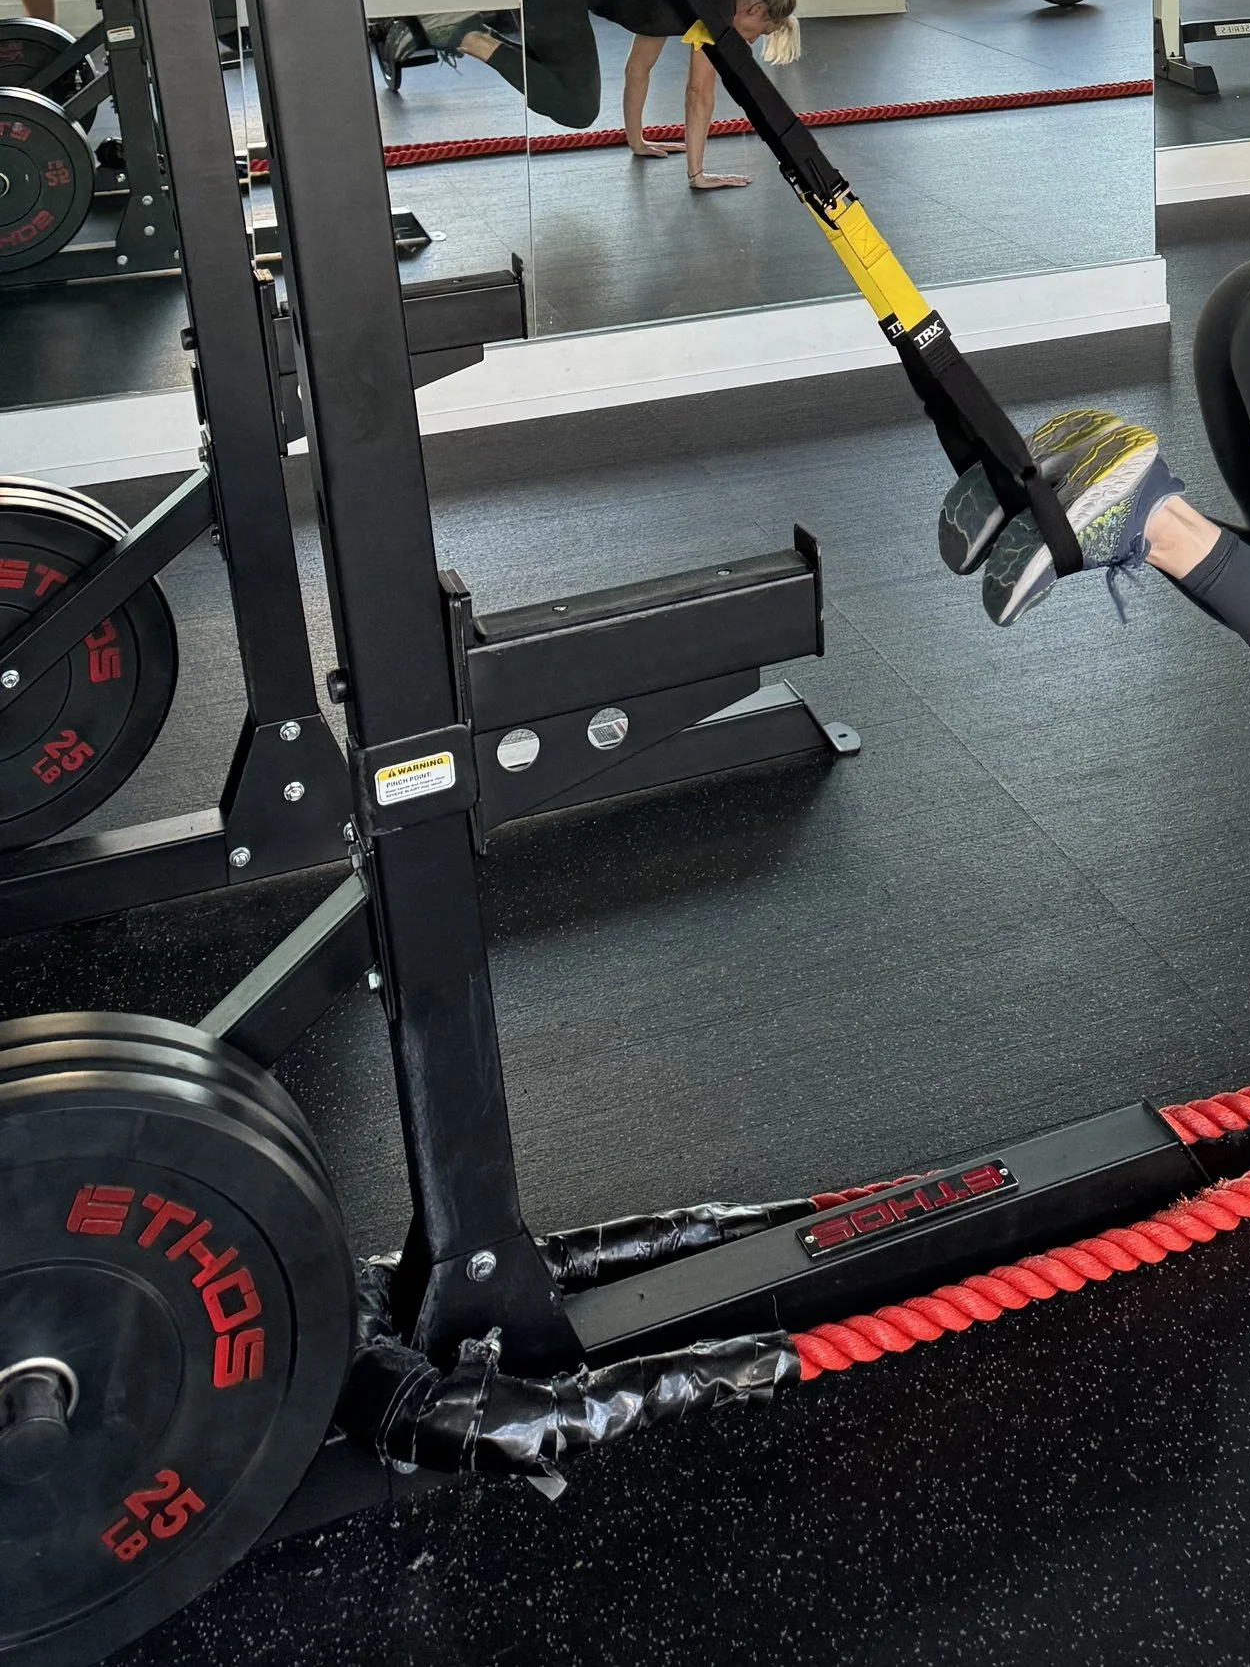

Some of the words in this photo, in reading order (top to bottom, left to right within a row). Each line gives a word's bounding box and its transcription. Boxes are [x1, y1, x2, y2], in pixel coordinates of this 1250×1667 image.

[914, 320, 943, 346] TRX
[32, 756, 62, 784] LB
[43, 730, 95, 771] 25
[397, 758, 444, 775] WARNING
[386, 777, 408, 788] PINCH
[810, 1165, 1005, 1248] ETHOS
[66, 1184, 265, 1389] ETHOS
[124, 1470, 206, 1538] 25
[101, 1517, 149, 1563] LB
